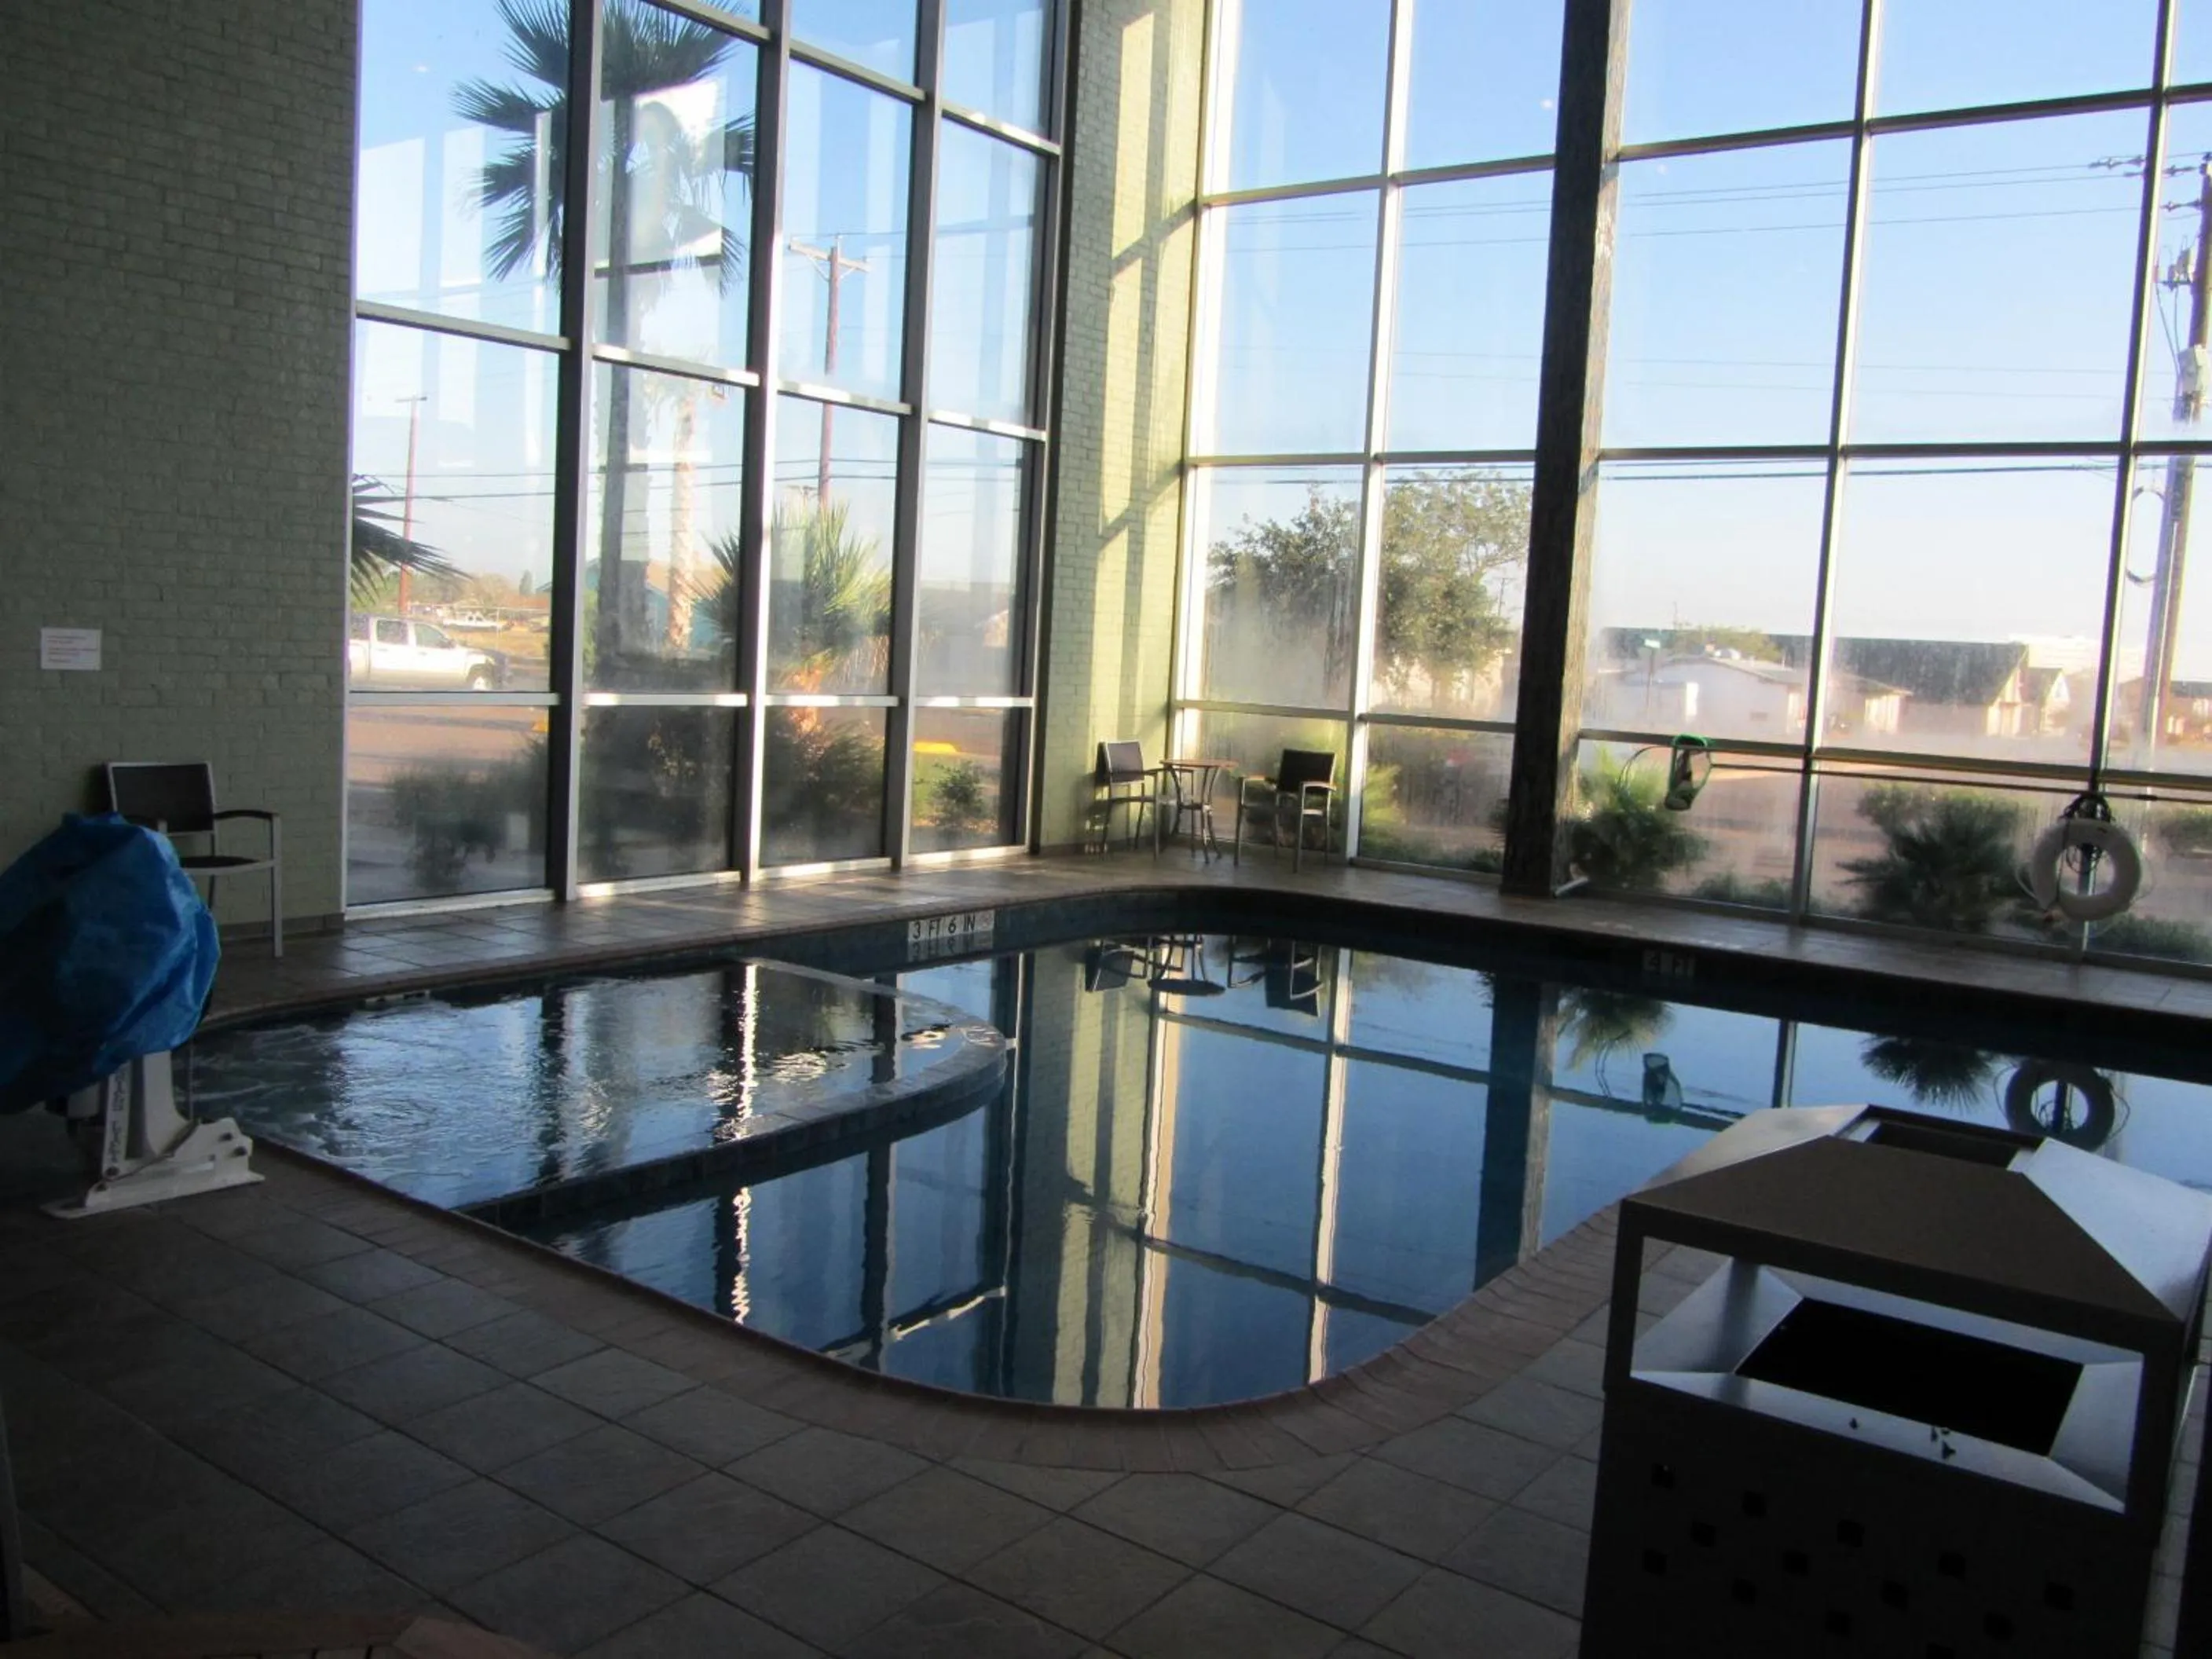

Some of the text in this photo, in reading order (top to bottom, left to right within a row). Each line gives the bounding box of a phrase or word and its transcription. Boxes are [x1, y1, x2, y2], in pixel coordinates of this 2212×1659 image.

[913, 911, 976, 939] 3 FT 6 IN
